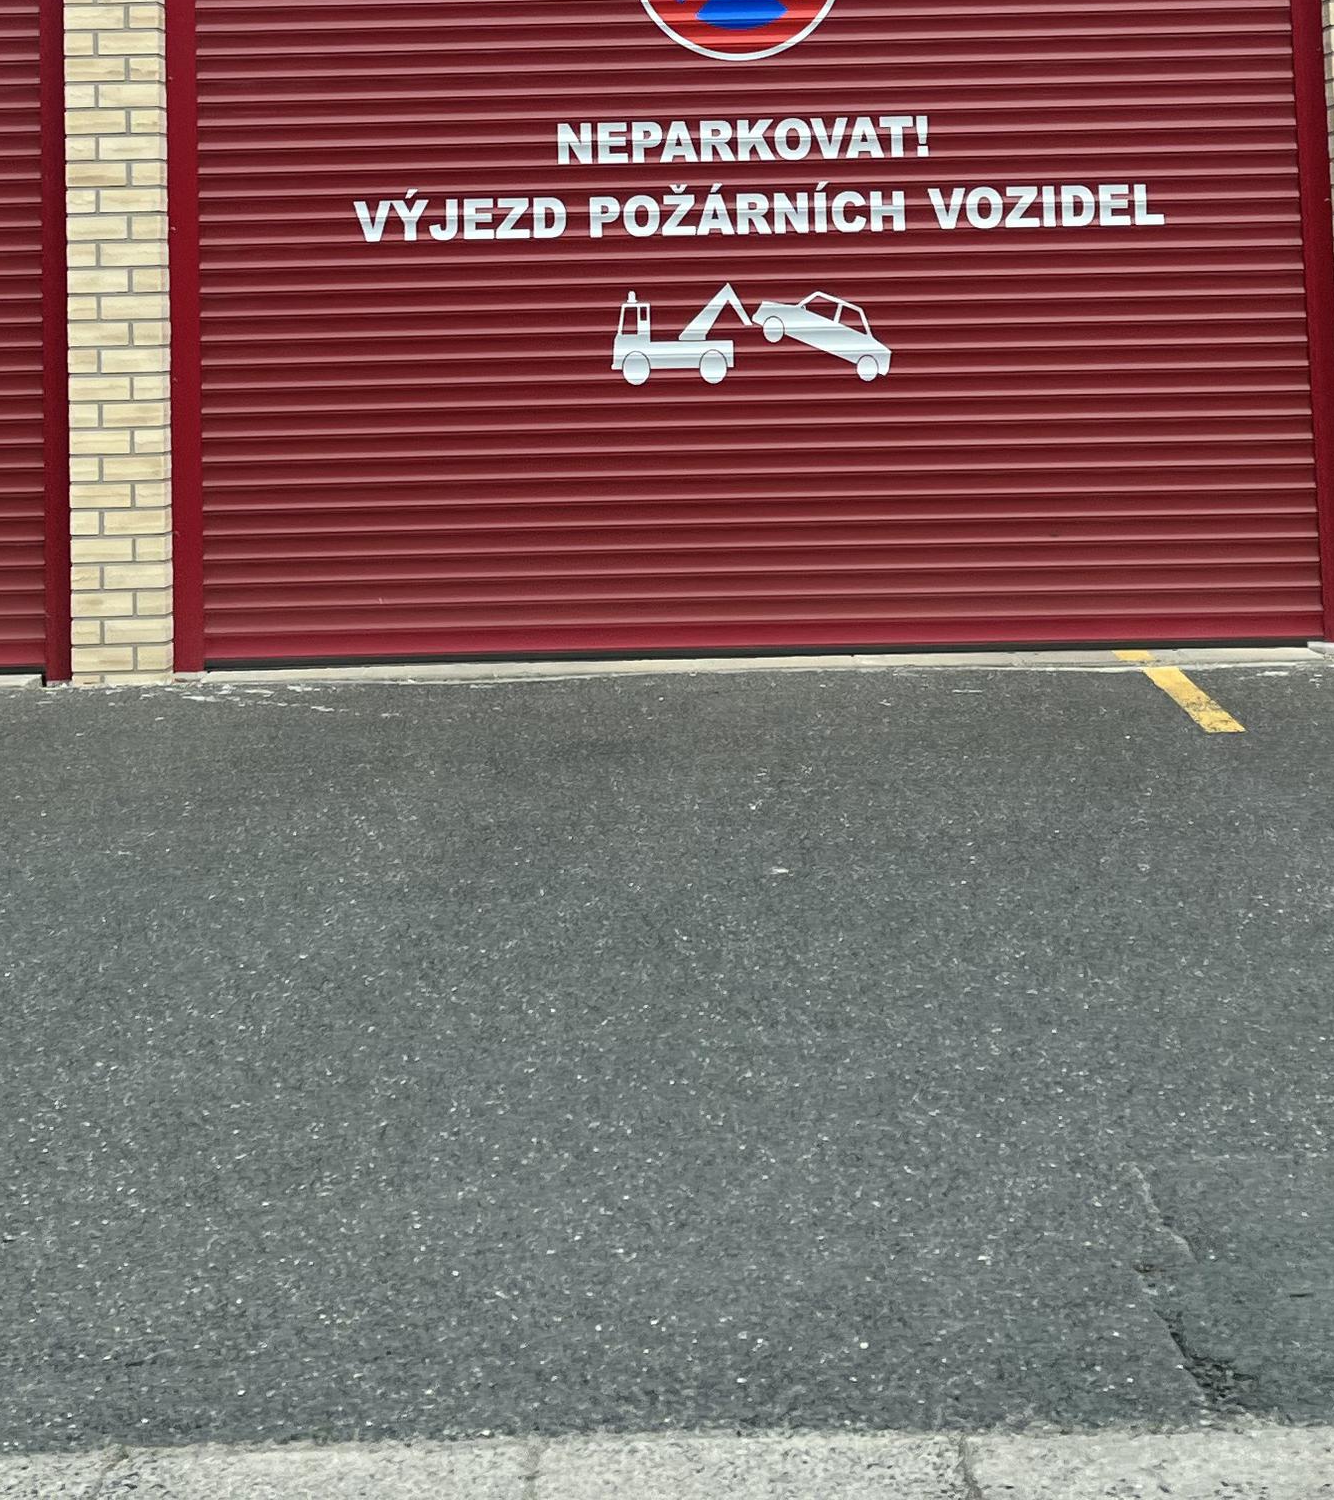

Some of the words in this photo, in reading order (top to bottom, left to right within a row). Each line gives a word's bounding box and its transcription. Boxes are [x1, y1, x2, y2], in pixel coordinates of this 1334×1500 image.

[557, 115, 931, 165] NEPARKOVAT!
[353, 188, 568, 243] VÝJEZD
[588, 181, 907, 238] POŽÁRNÍCH
[928, 183, 1166, 231] VOZIDEL
